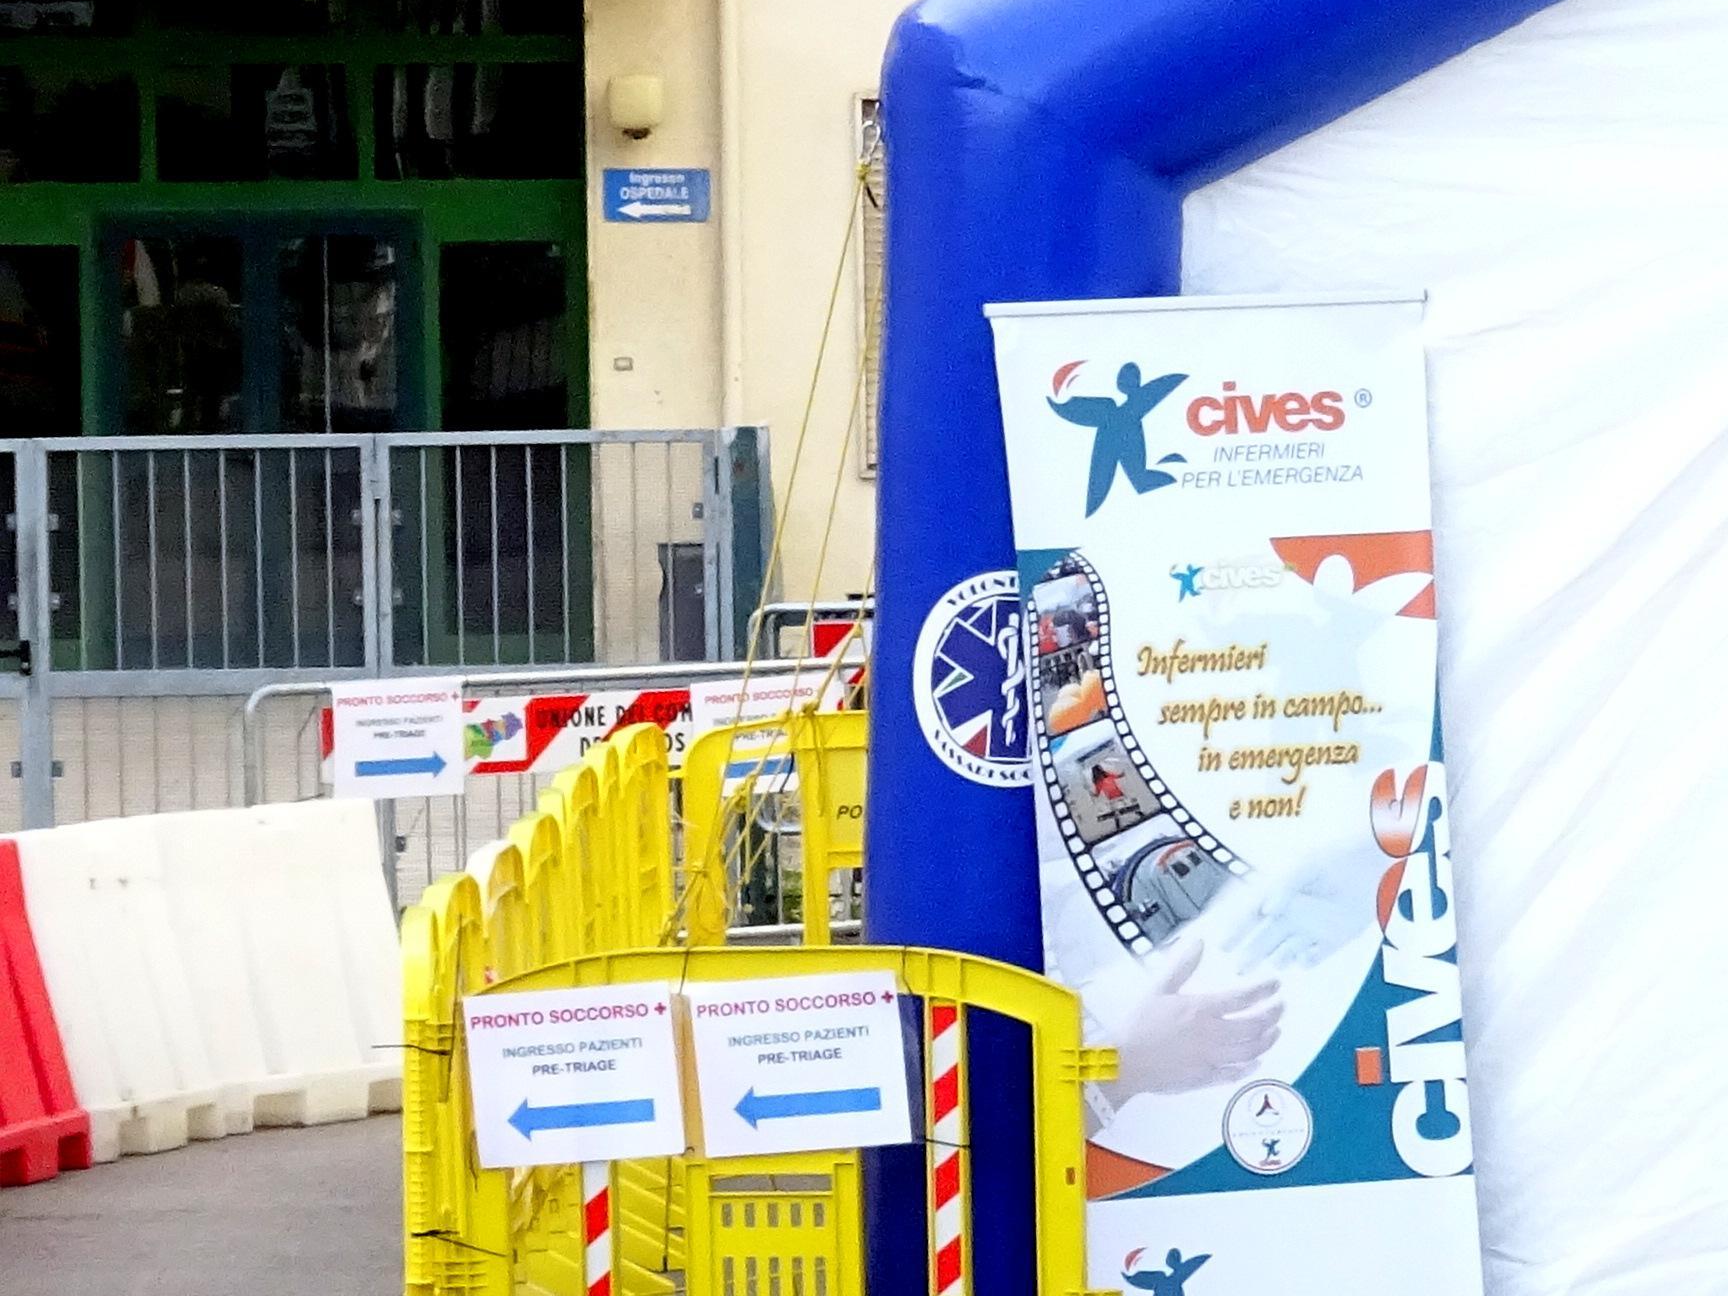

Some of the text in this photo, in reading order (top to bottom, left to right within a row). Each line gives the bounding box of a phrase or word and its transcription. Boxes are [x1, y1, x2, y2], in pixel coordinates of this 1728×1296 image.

[620, 186, 689, 200] OSPEDALE
[1186, 380, 1346, 437] cives
[1213, 441, 1325, 464] INFERMIERI
[1181, 464, 1364, 489] PER L'EMERGENZA
[1136, 638, 1268, 685] Infermieri
[336, 691, 449, 708] PRONTO SOCCORSO
[1158, 696, 1247, 741] sempre
[1252, 692, 1278, 720] in
[1197, 743, 1360, 785] in emergenza
[1229, 785, 1307, 820] e non!
[1354, 759, 1475, 1179] cives
[470, 1002, 650, 1030] PRONTO SOCCORSO
[695, 990, 877, 1019] PRONTO SOCCORSO
[501, 1036, 643, 1059] INGRESSO PAZIENTI
[727, 1025, 870, 1048] INGRESSO PAZIENTI
[531, 1058, 617, 1076] PRE-TRIAGE
[756, 1046, 843, 1065] PRE-TRIAGE
